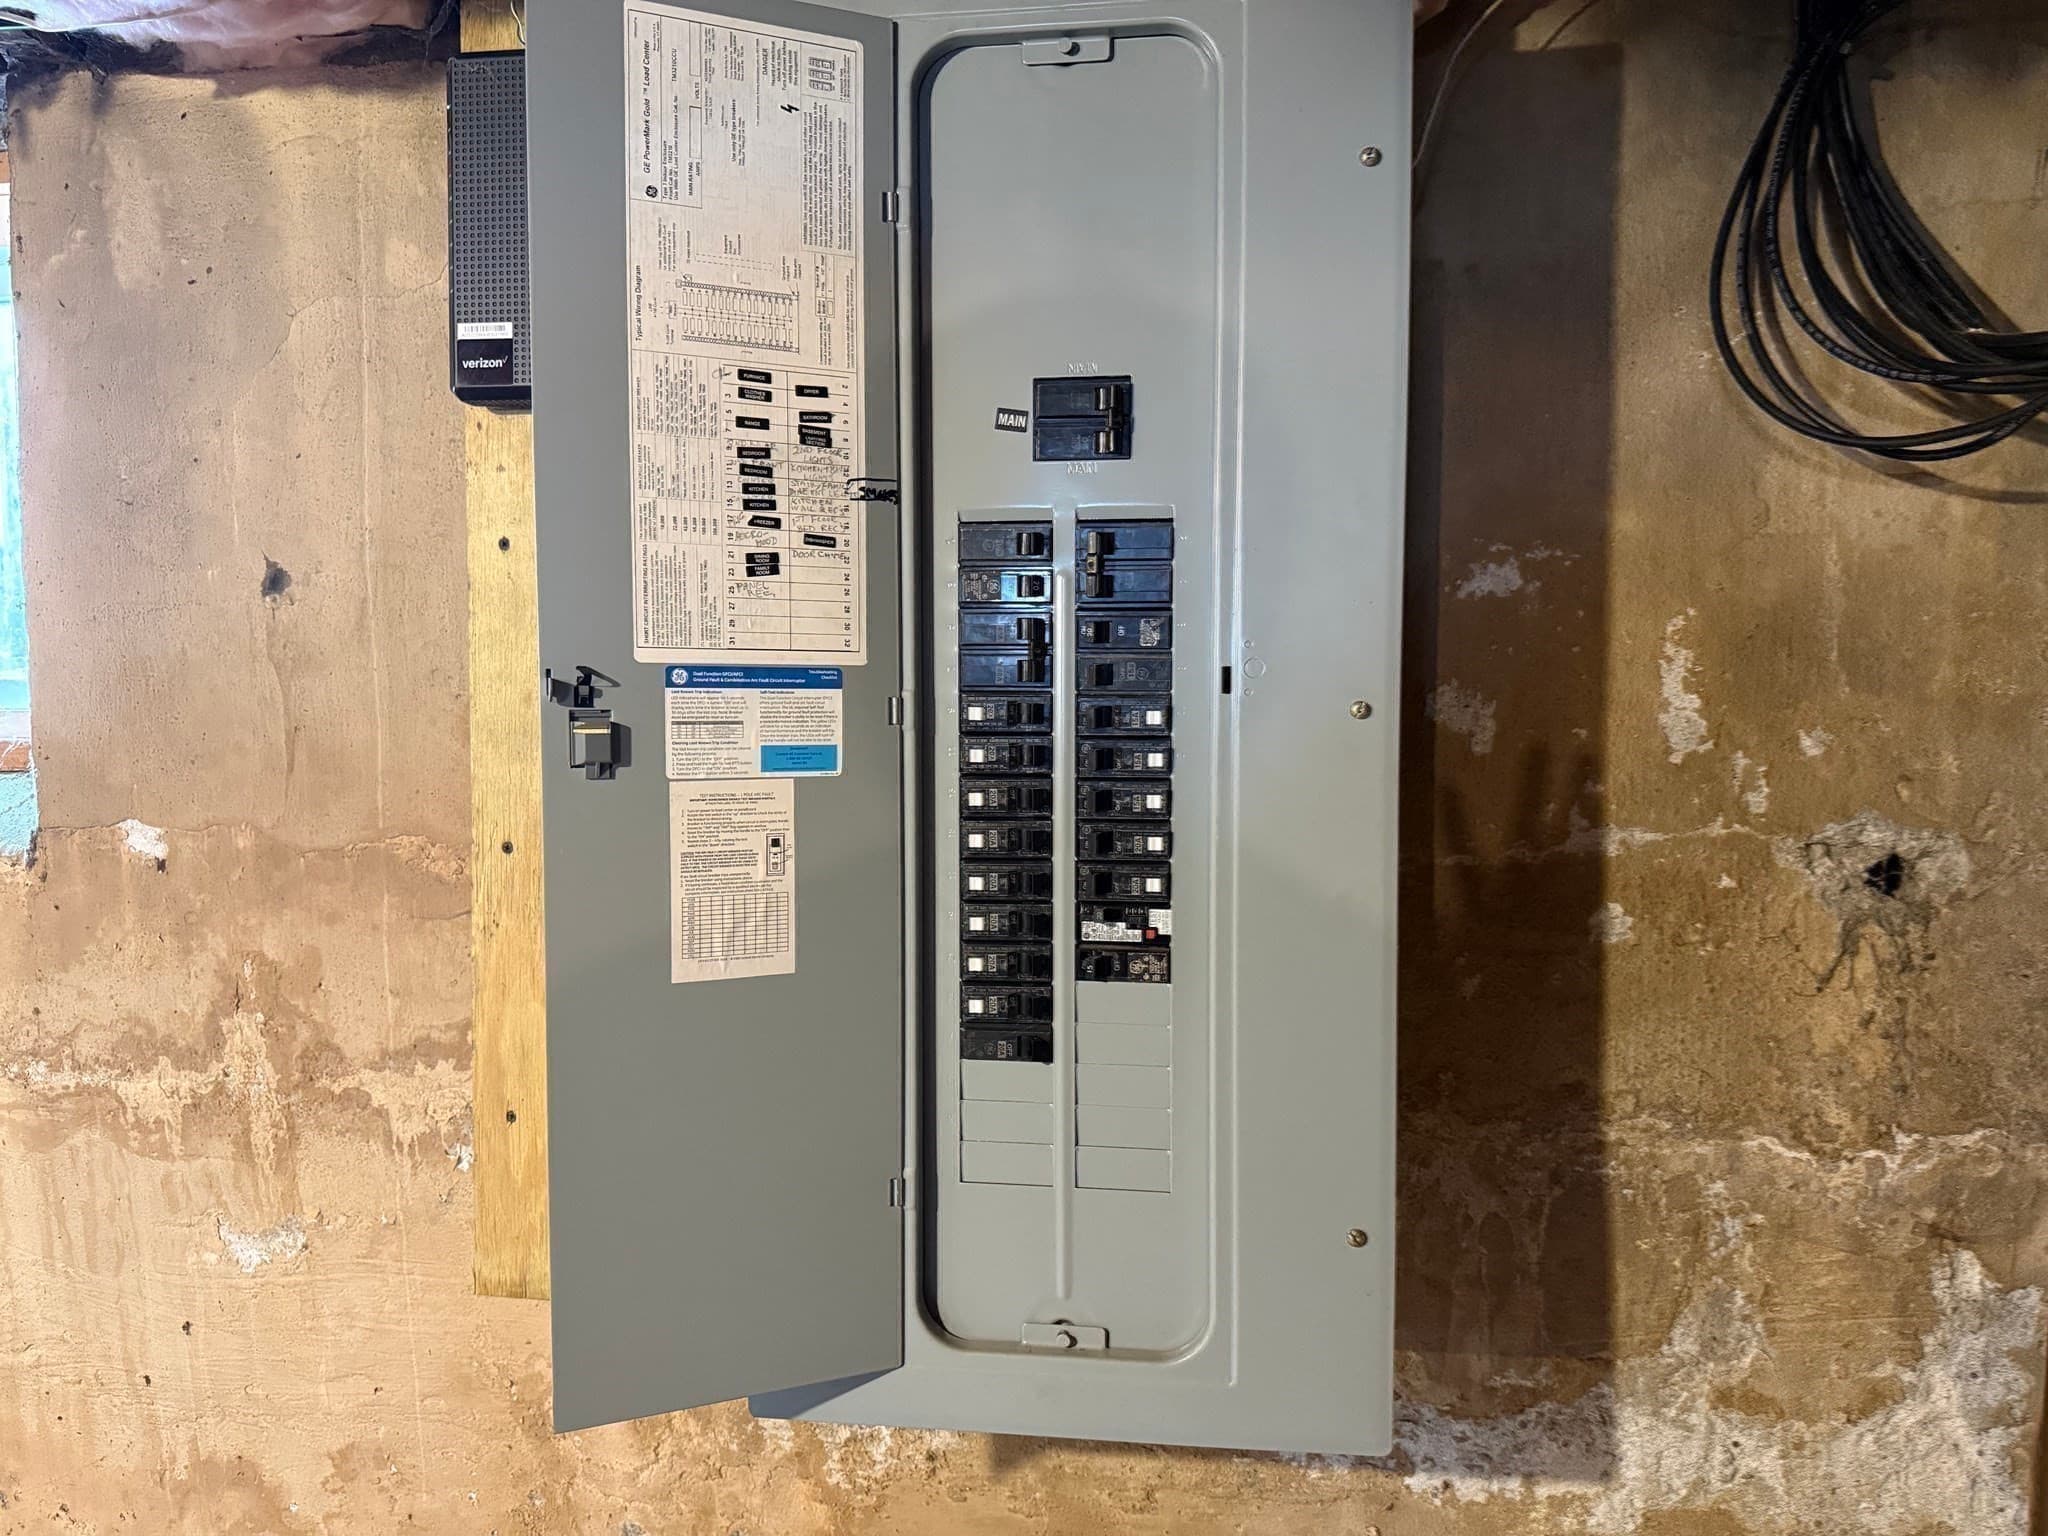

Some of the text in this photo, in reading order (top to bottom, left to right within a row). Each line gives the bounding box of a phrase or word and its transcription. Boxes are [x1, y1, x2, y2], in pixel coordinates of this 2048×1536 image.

[643, 98, 651, 117] Gold
[643, 120, 651, 161] PowerMark
[643, 162, 651, 174] GE
[634, 265, 642, 293] Diagram
[462, 357, 503, 368] verizon
[997, 413, 1027, 428] MAIN
[727, 481, 733, 489] 13
[727, 498, 733, 506] 15
[727, 532, 733, 540] 19
[729, 568, 735, 576] 23
[844, 573, 850, 581] 24
[729, 586, 735, 594] 25
[736, 582, 769, 592] PANEL
[844, 588, 850, 596] 26
[729, 602, 735, 610] 27
[729, 619, 735, 627] 29
[844, 622, 850, 631] 30
[729, 636, 735, 645] 31
[844, 639, 850, 648] 32
[989, 790, 997, 806] 20A
[989, 831, 997, 847] 20A
[1134, 836, 1142, 853] 20A
[990, 914, 998, 931] 20A
[988, 955, 996, 971] 20A
[989, 997, 997, 1014] 20A
